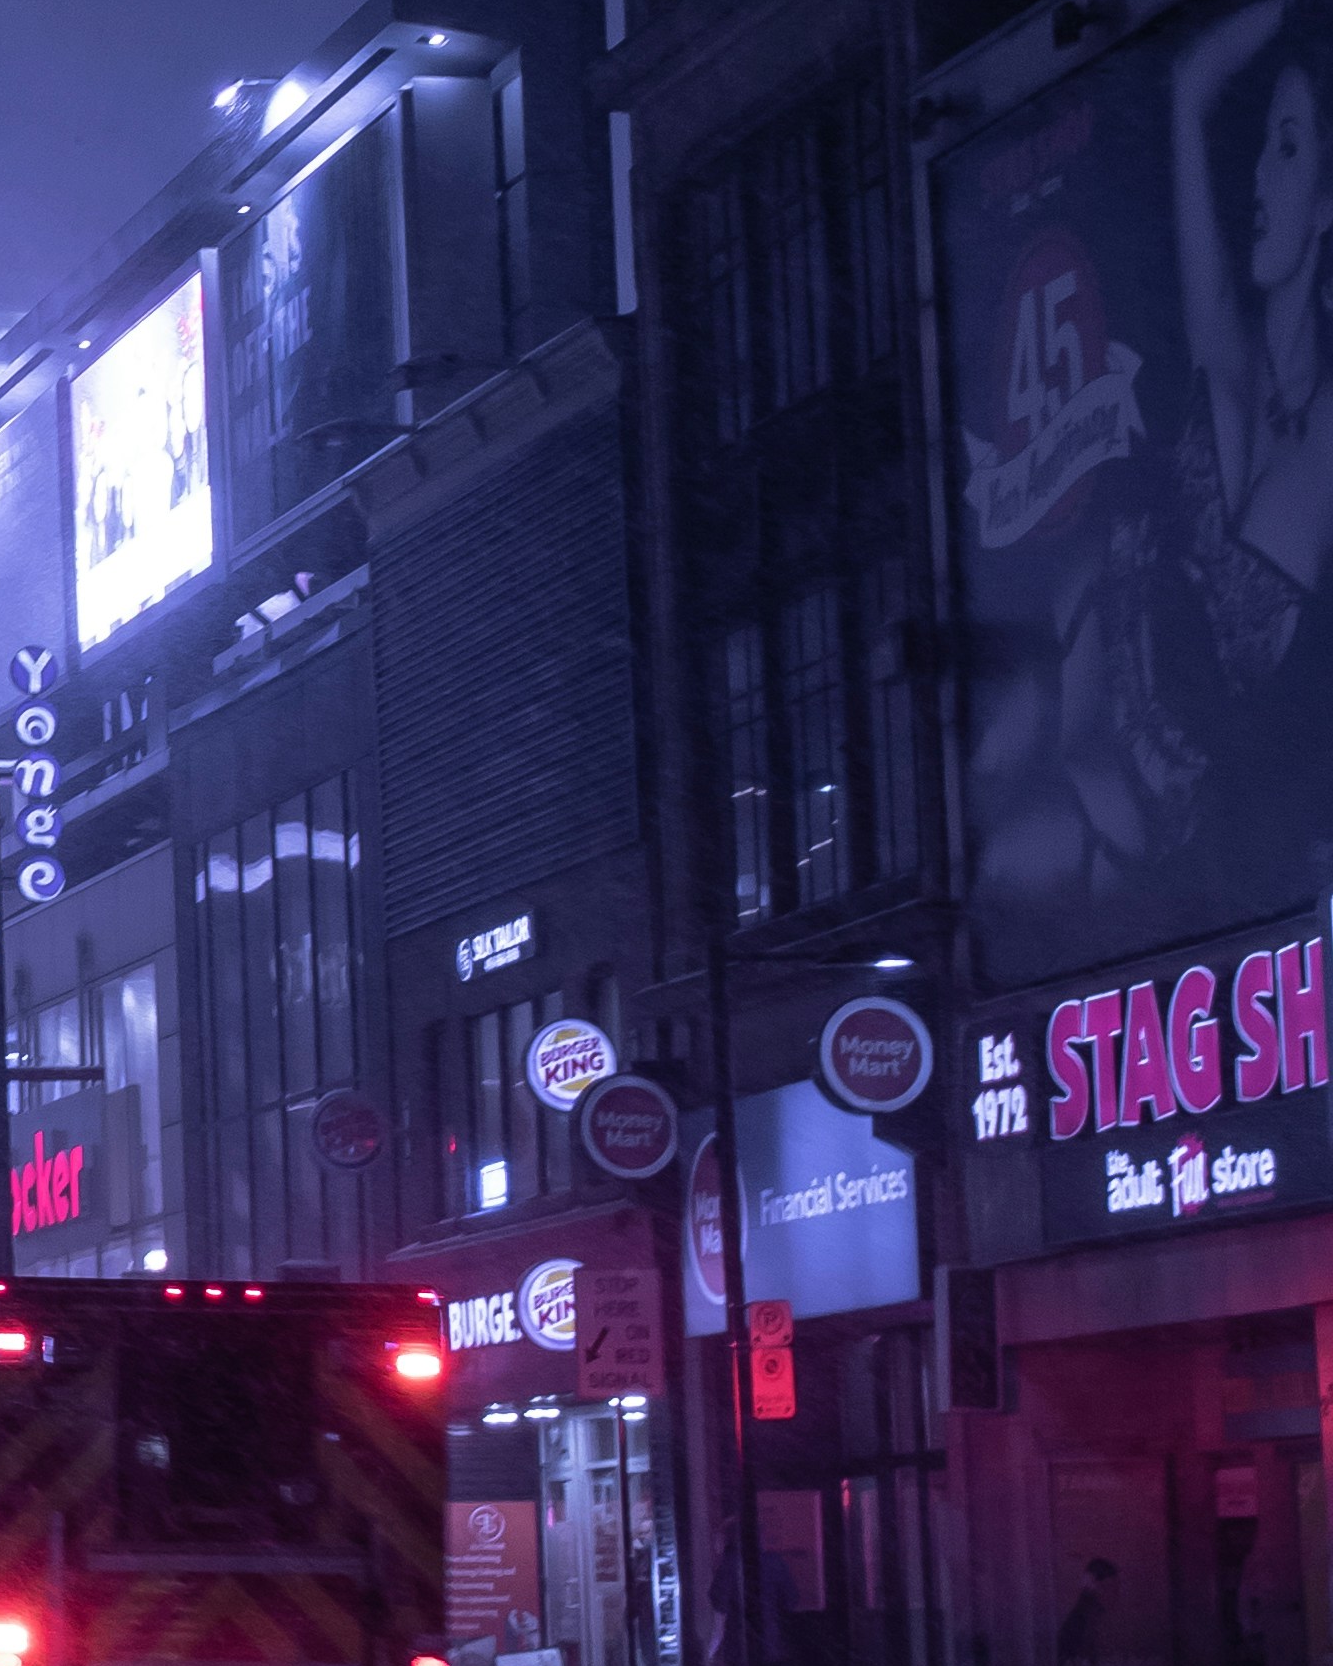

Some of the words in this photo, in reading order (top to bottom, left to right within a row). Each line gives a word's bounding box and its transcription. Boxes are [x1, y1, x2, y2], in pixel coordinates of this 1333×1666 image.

[540, 1036, 601, 1068] BURGER
[839, 1034, 916, 1065] Money
[1045, 965, 1223, 1141] STAG
[1231, 936, 1330, 1104] SH
[543, 1051, 605, 1089] KING
[848, 1057, 902, 1078] Mart
[977, 1032, 1021, 1083] Est.
[595, 1111, 663, 1133] Money
[971, 1084, 1029, 1142] 1972
[604, 1130, 654, 1149] Mart
[1107, 1159, 1165, 1213] adult
[1211, 1145, 1277, 1194] store
[758, 1174, 834, 1227] Financial
[834, 1164, 908, 1212] Services
[594, 1277, 639, 1294] STOP
[625, 1324, 650, 1341] ON
[614, 1347, 651, 1364] RED
